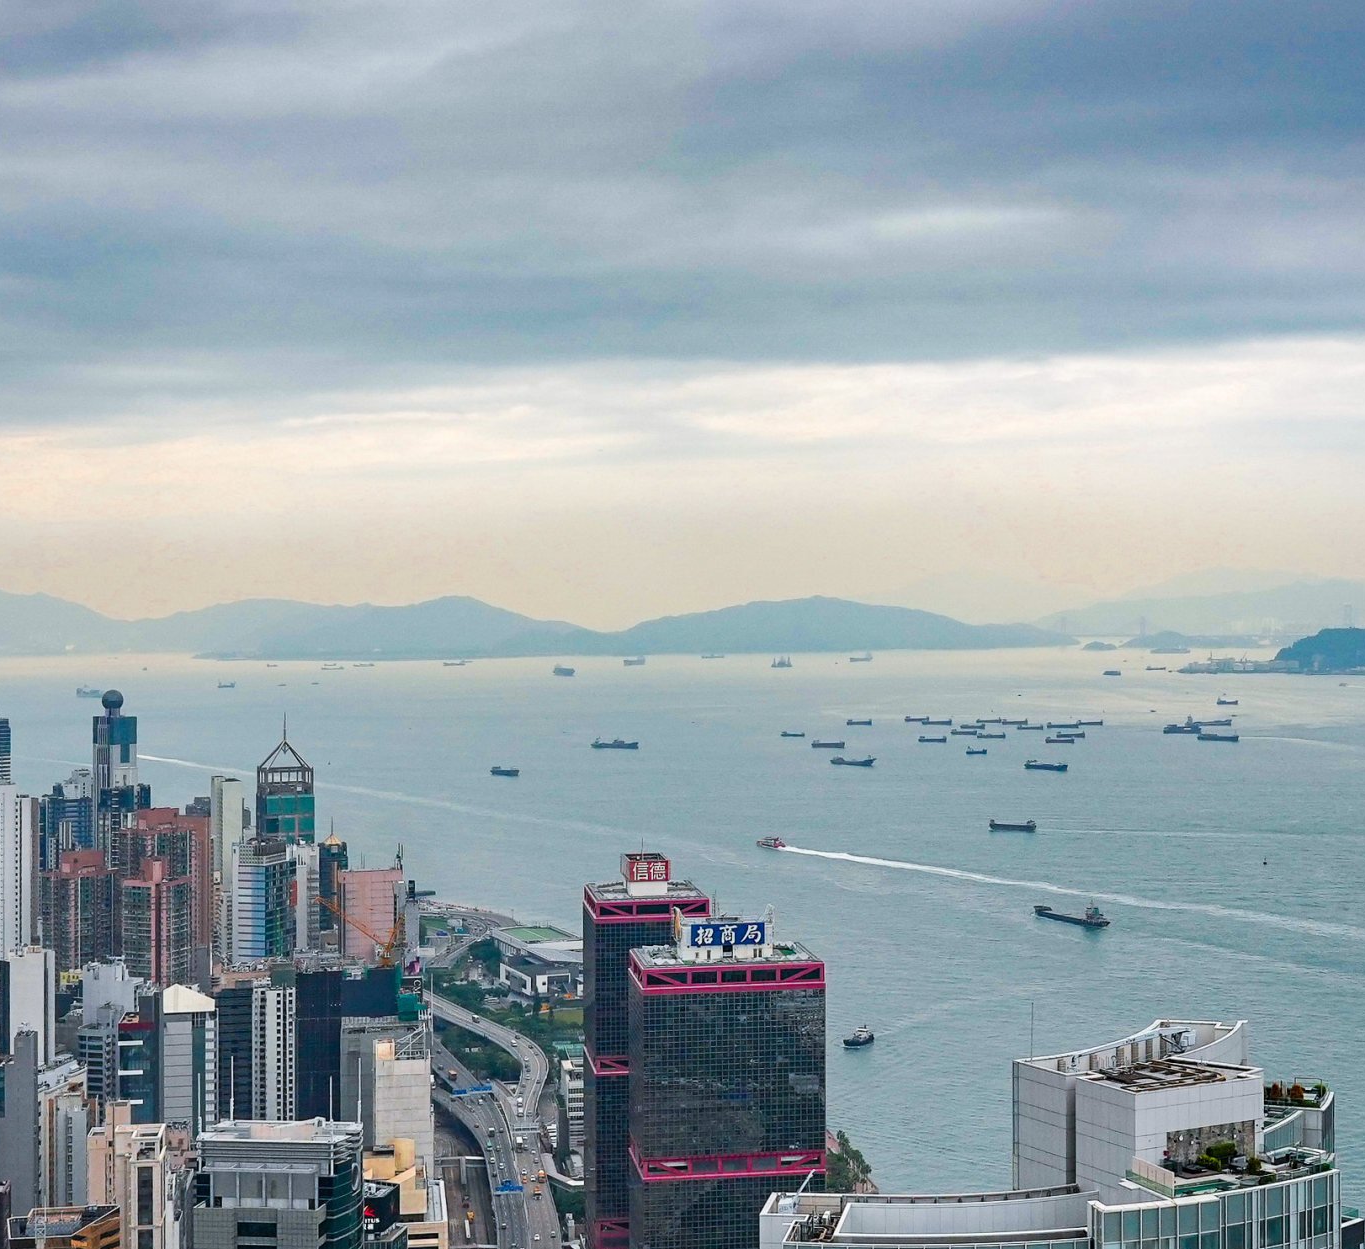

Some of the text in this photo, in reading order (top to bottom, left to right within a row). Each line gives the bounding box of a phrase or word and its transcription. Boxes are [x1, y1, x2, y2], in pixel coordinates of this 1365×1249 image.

[632, 862, 666, 881] 信德
[694, 923, 762, 945] 招商局
